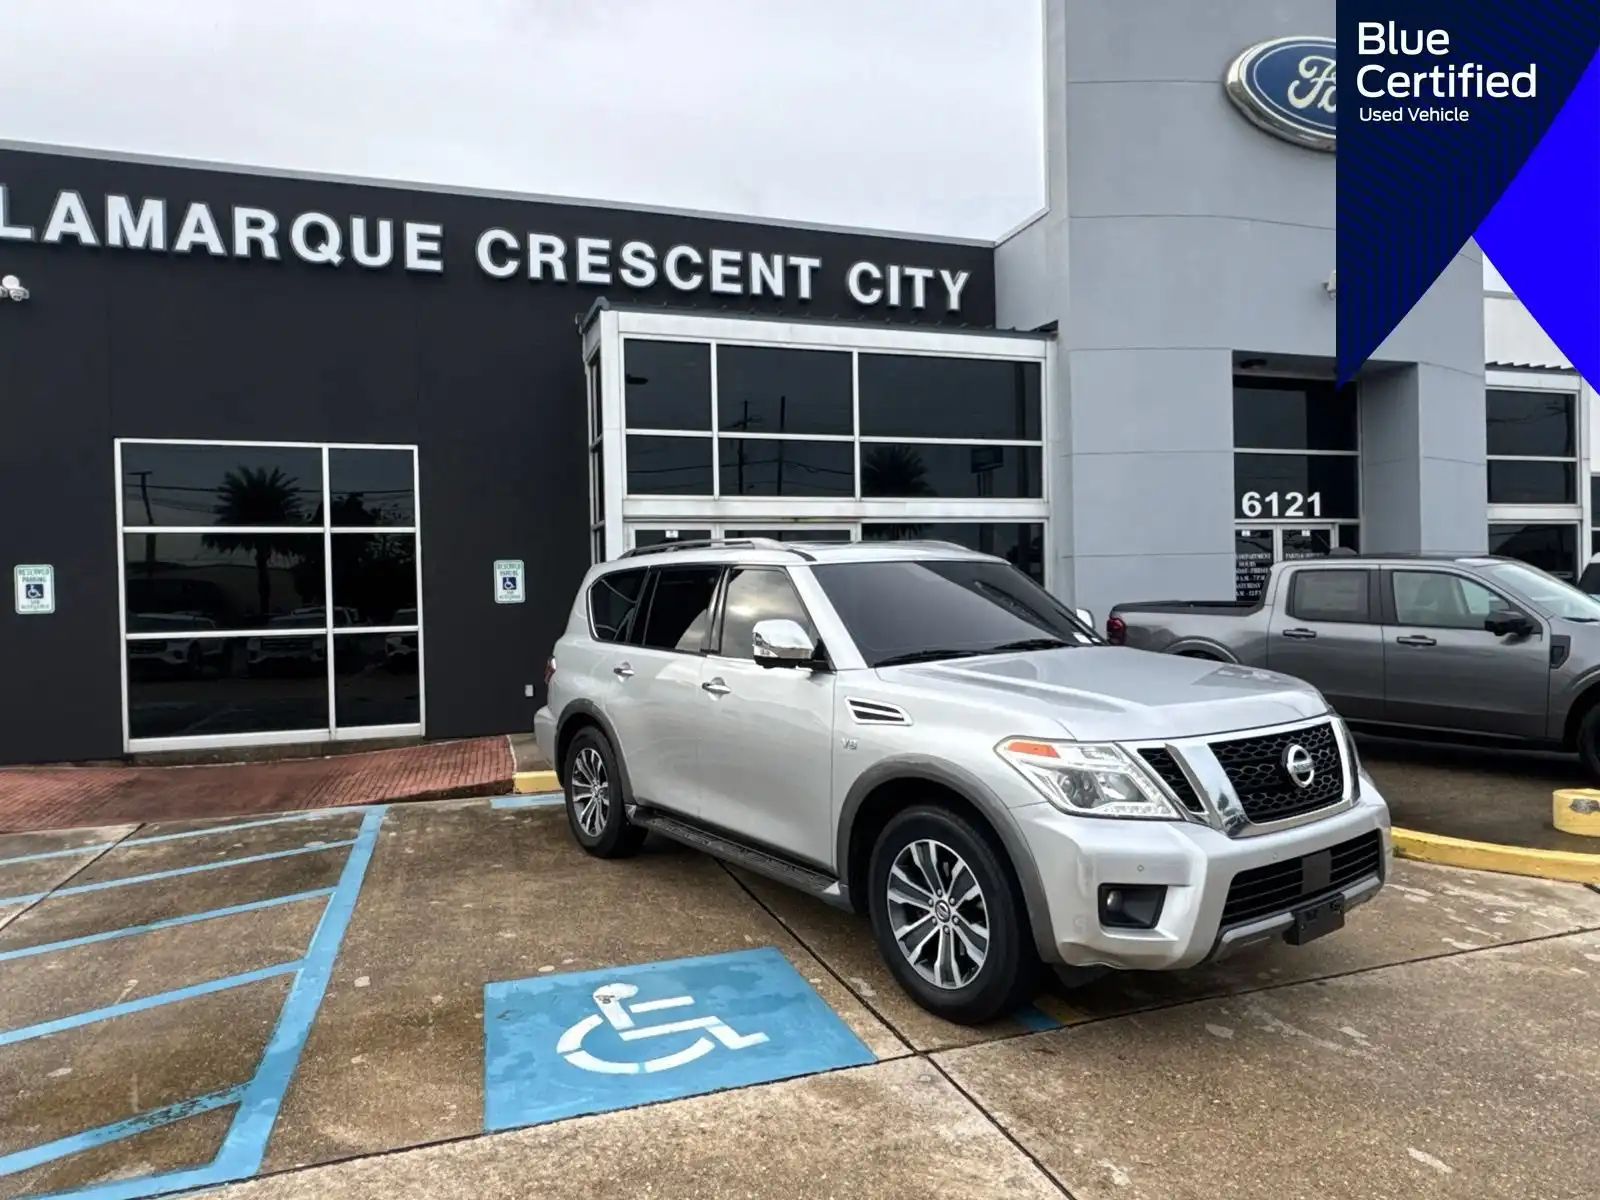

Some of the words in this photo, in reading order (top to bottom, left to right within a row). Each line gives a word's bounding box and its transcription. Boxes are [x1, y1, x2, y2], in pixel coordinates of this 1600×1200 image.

[1287, 55, 1336, 114] Fo
[0, 184, 445, 273] LAMARQUE
[475, 228, 821, 299] CRESCENT
[847, 260, 971, 311] CITY
[1241, 491, 1321, 517] 6121
[841, 738, 857, 751] V8
